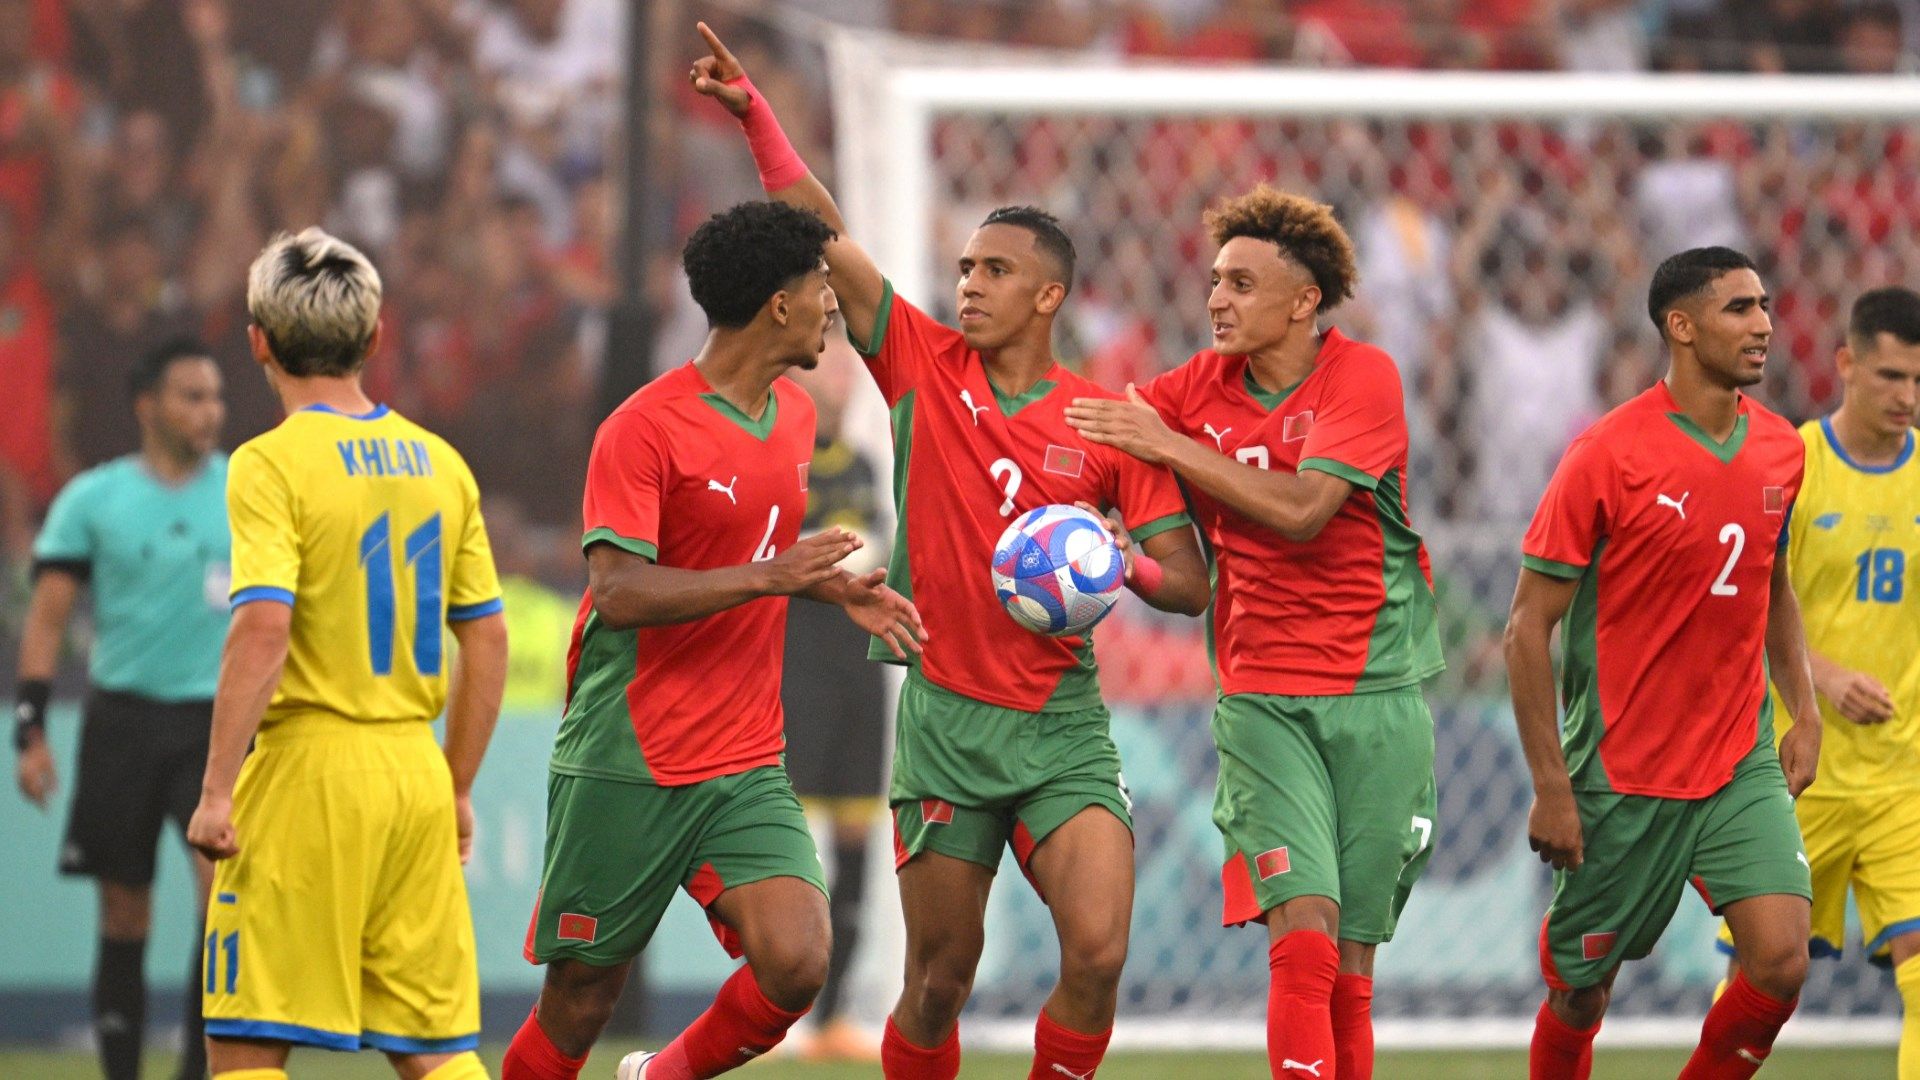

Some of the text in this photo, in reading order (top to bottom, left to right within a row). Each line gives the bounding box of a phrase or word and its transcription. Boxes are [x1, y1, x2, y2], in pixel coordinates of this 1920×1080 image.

[336, 438, 433, 476] KHLAN
[1710, 523, 1745, 595] 2
[1856, 548, 1905, 603] 18
[359, 511, 442, 676] 11
[206, 928, 239, 994] 11
